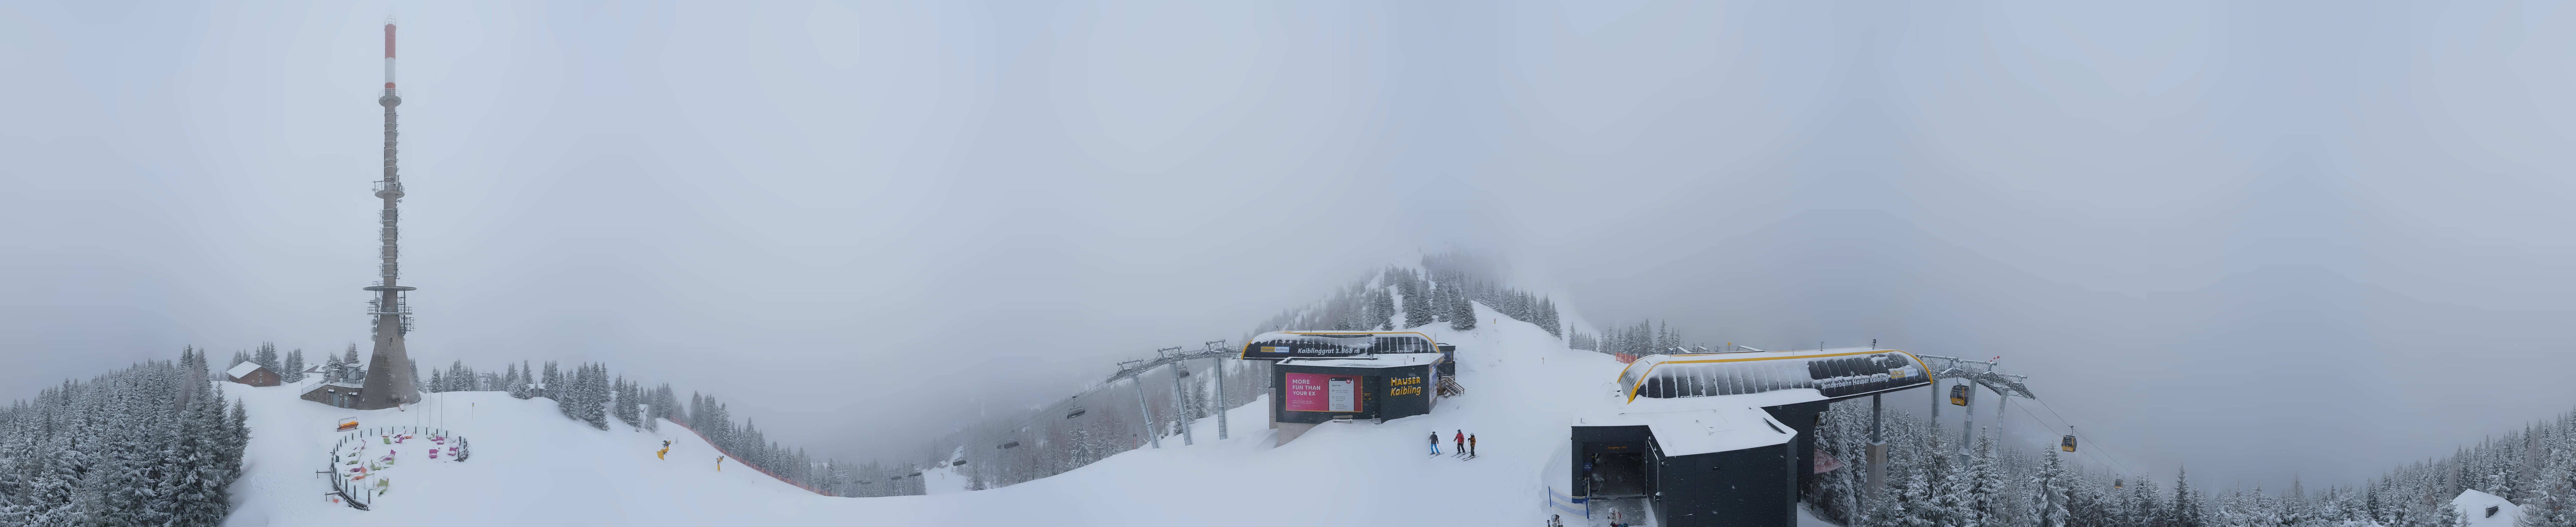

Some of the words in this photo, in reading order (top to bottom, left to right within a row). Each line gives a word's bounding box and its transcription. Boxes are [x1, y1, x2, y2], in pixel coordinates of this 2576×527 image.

[1391, 377, 1420, 386] HAUSER
[1821, 380, 1852, 389] Senderbahn
[1391, 386, 1421, 396] Kaibling
